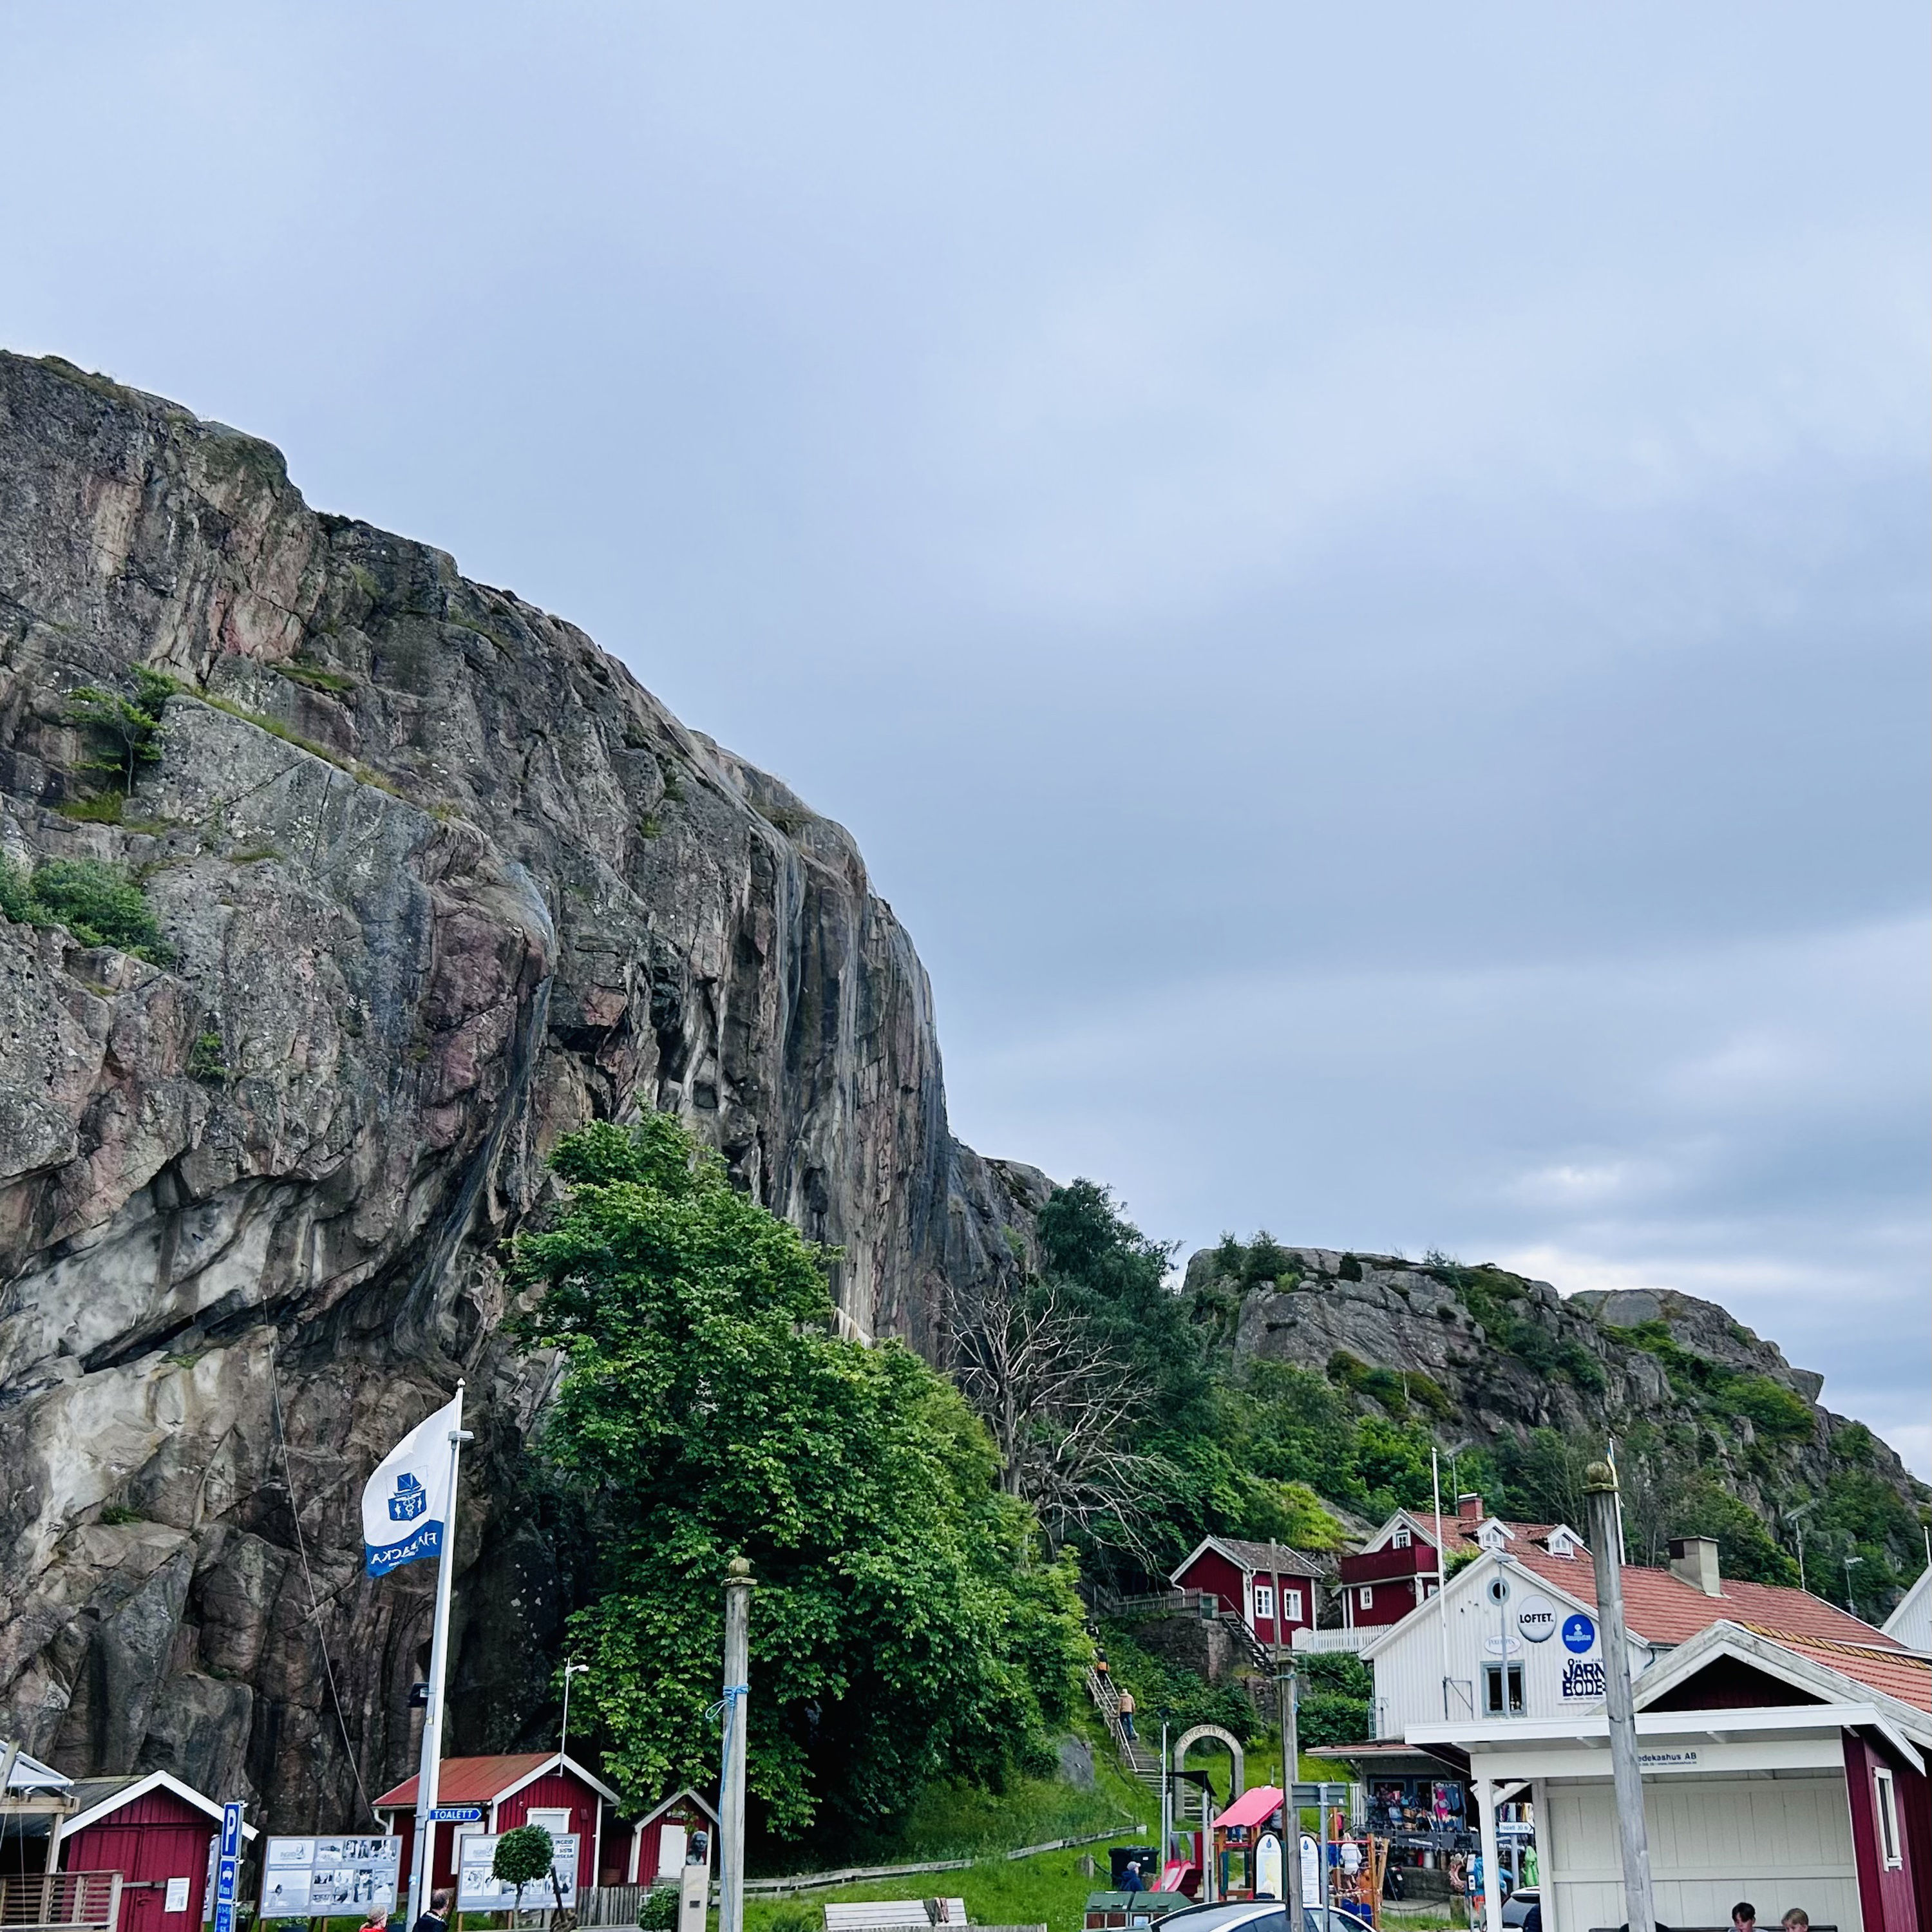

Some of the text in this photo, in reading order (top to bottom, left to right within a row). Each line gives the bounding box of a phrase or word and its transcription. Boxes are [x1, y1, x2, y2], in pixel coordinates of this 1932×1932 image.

[1562, 1680, 1606, 1697] BODE
[1638, 1752, 1697, 1762] edekashus AB
[434, 1810, 473, 1819] TOALETT
[225, 1808, 237, 1852] P
